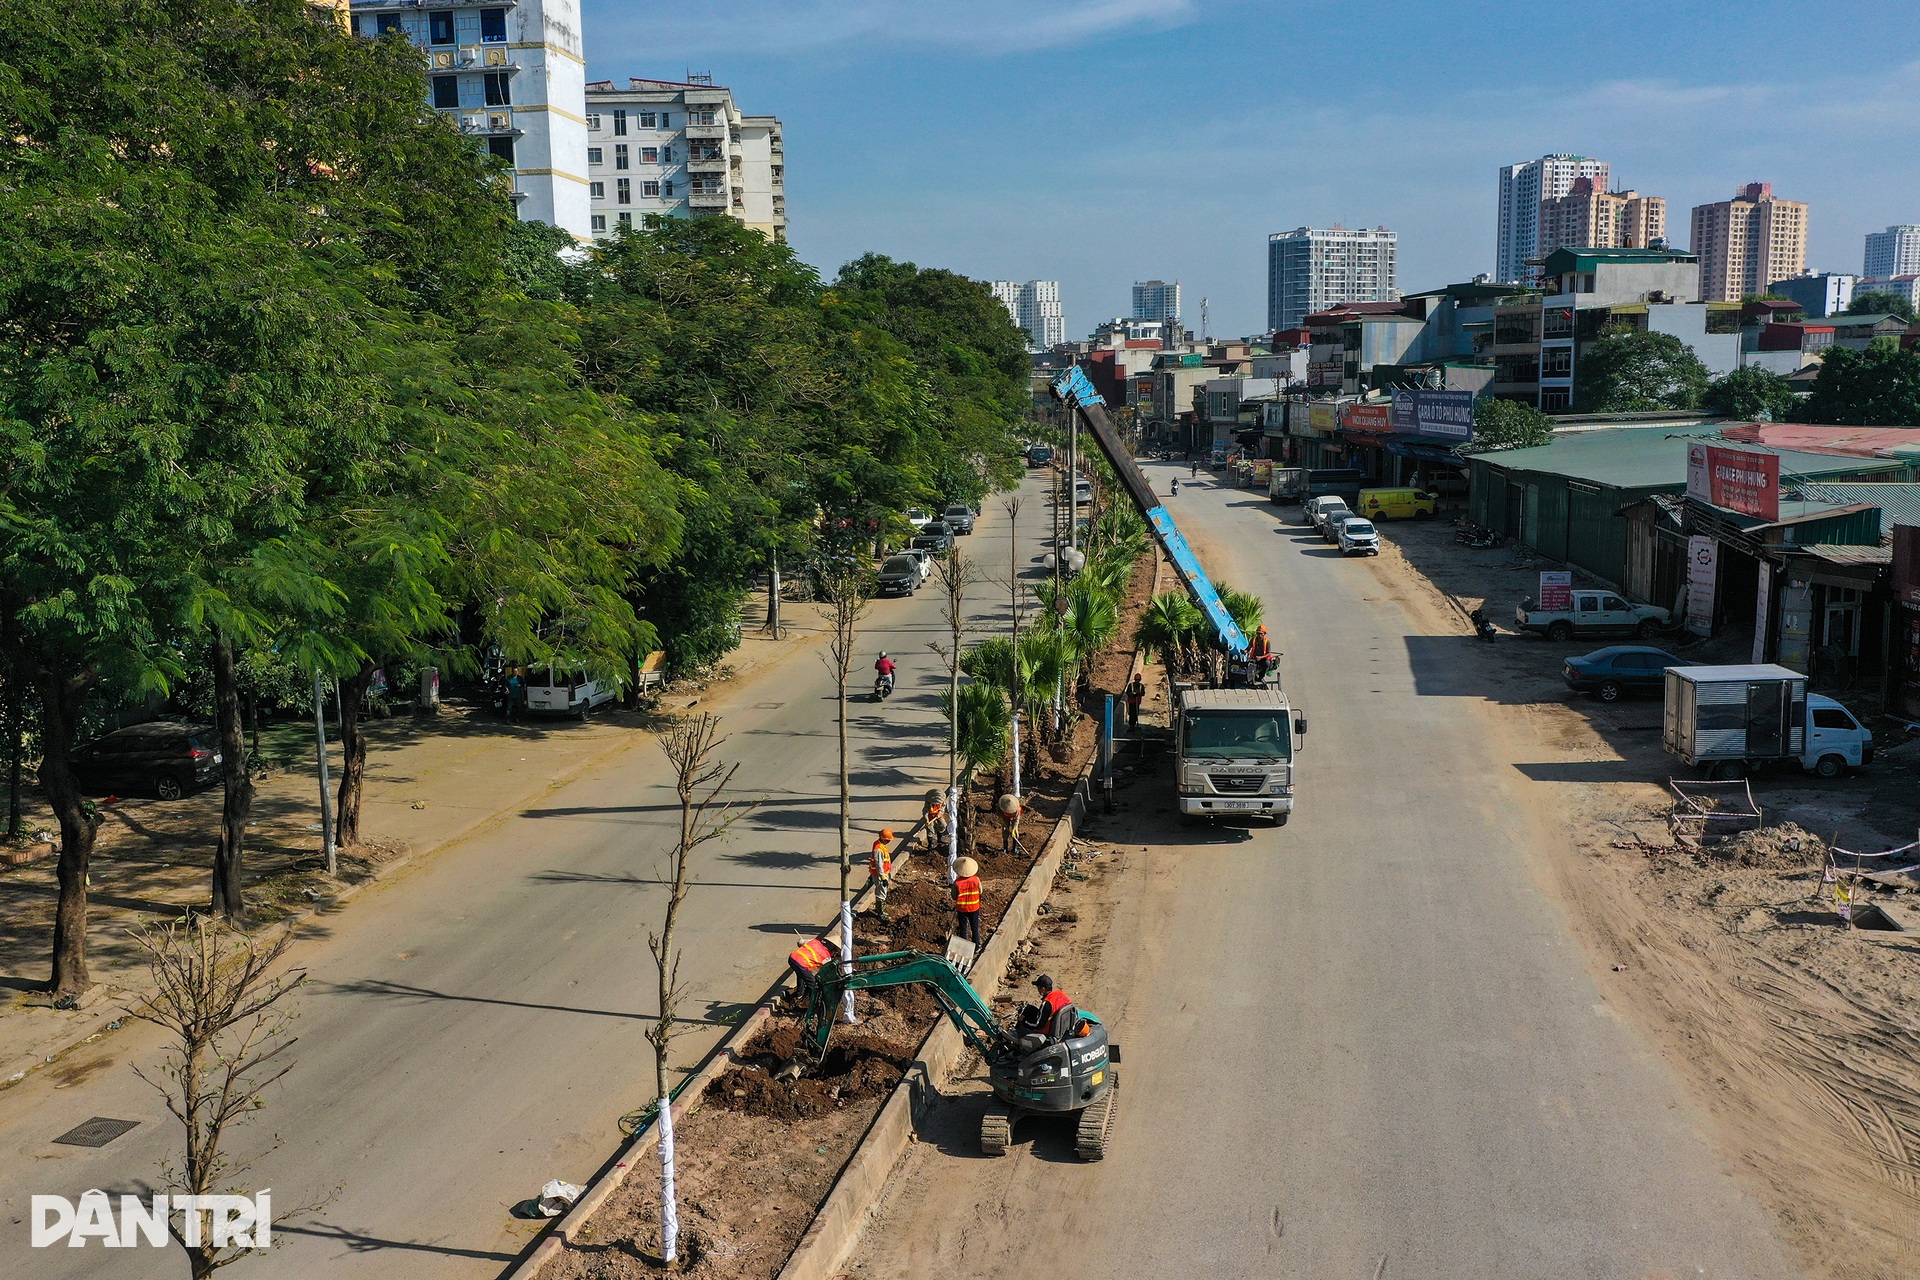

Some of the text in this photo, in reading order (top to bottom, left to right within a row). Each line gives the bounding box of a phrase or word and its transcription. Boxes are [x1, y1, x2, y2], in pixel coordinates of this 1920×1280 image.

[1418, 404, 1431, 420] GARA
[1443, 403, 1454, 421] PHÚ
[1081, 1045, 1106, 1064] KOBELCO
